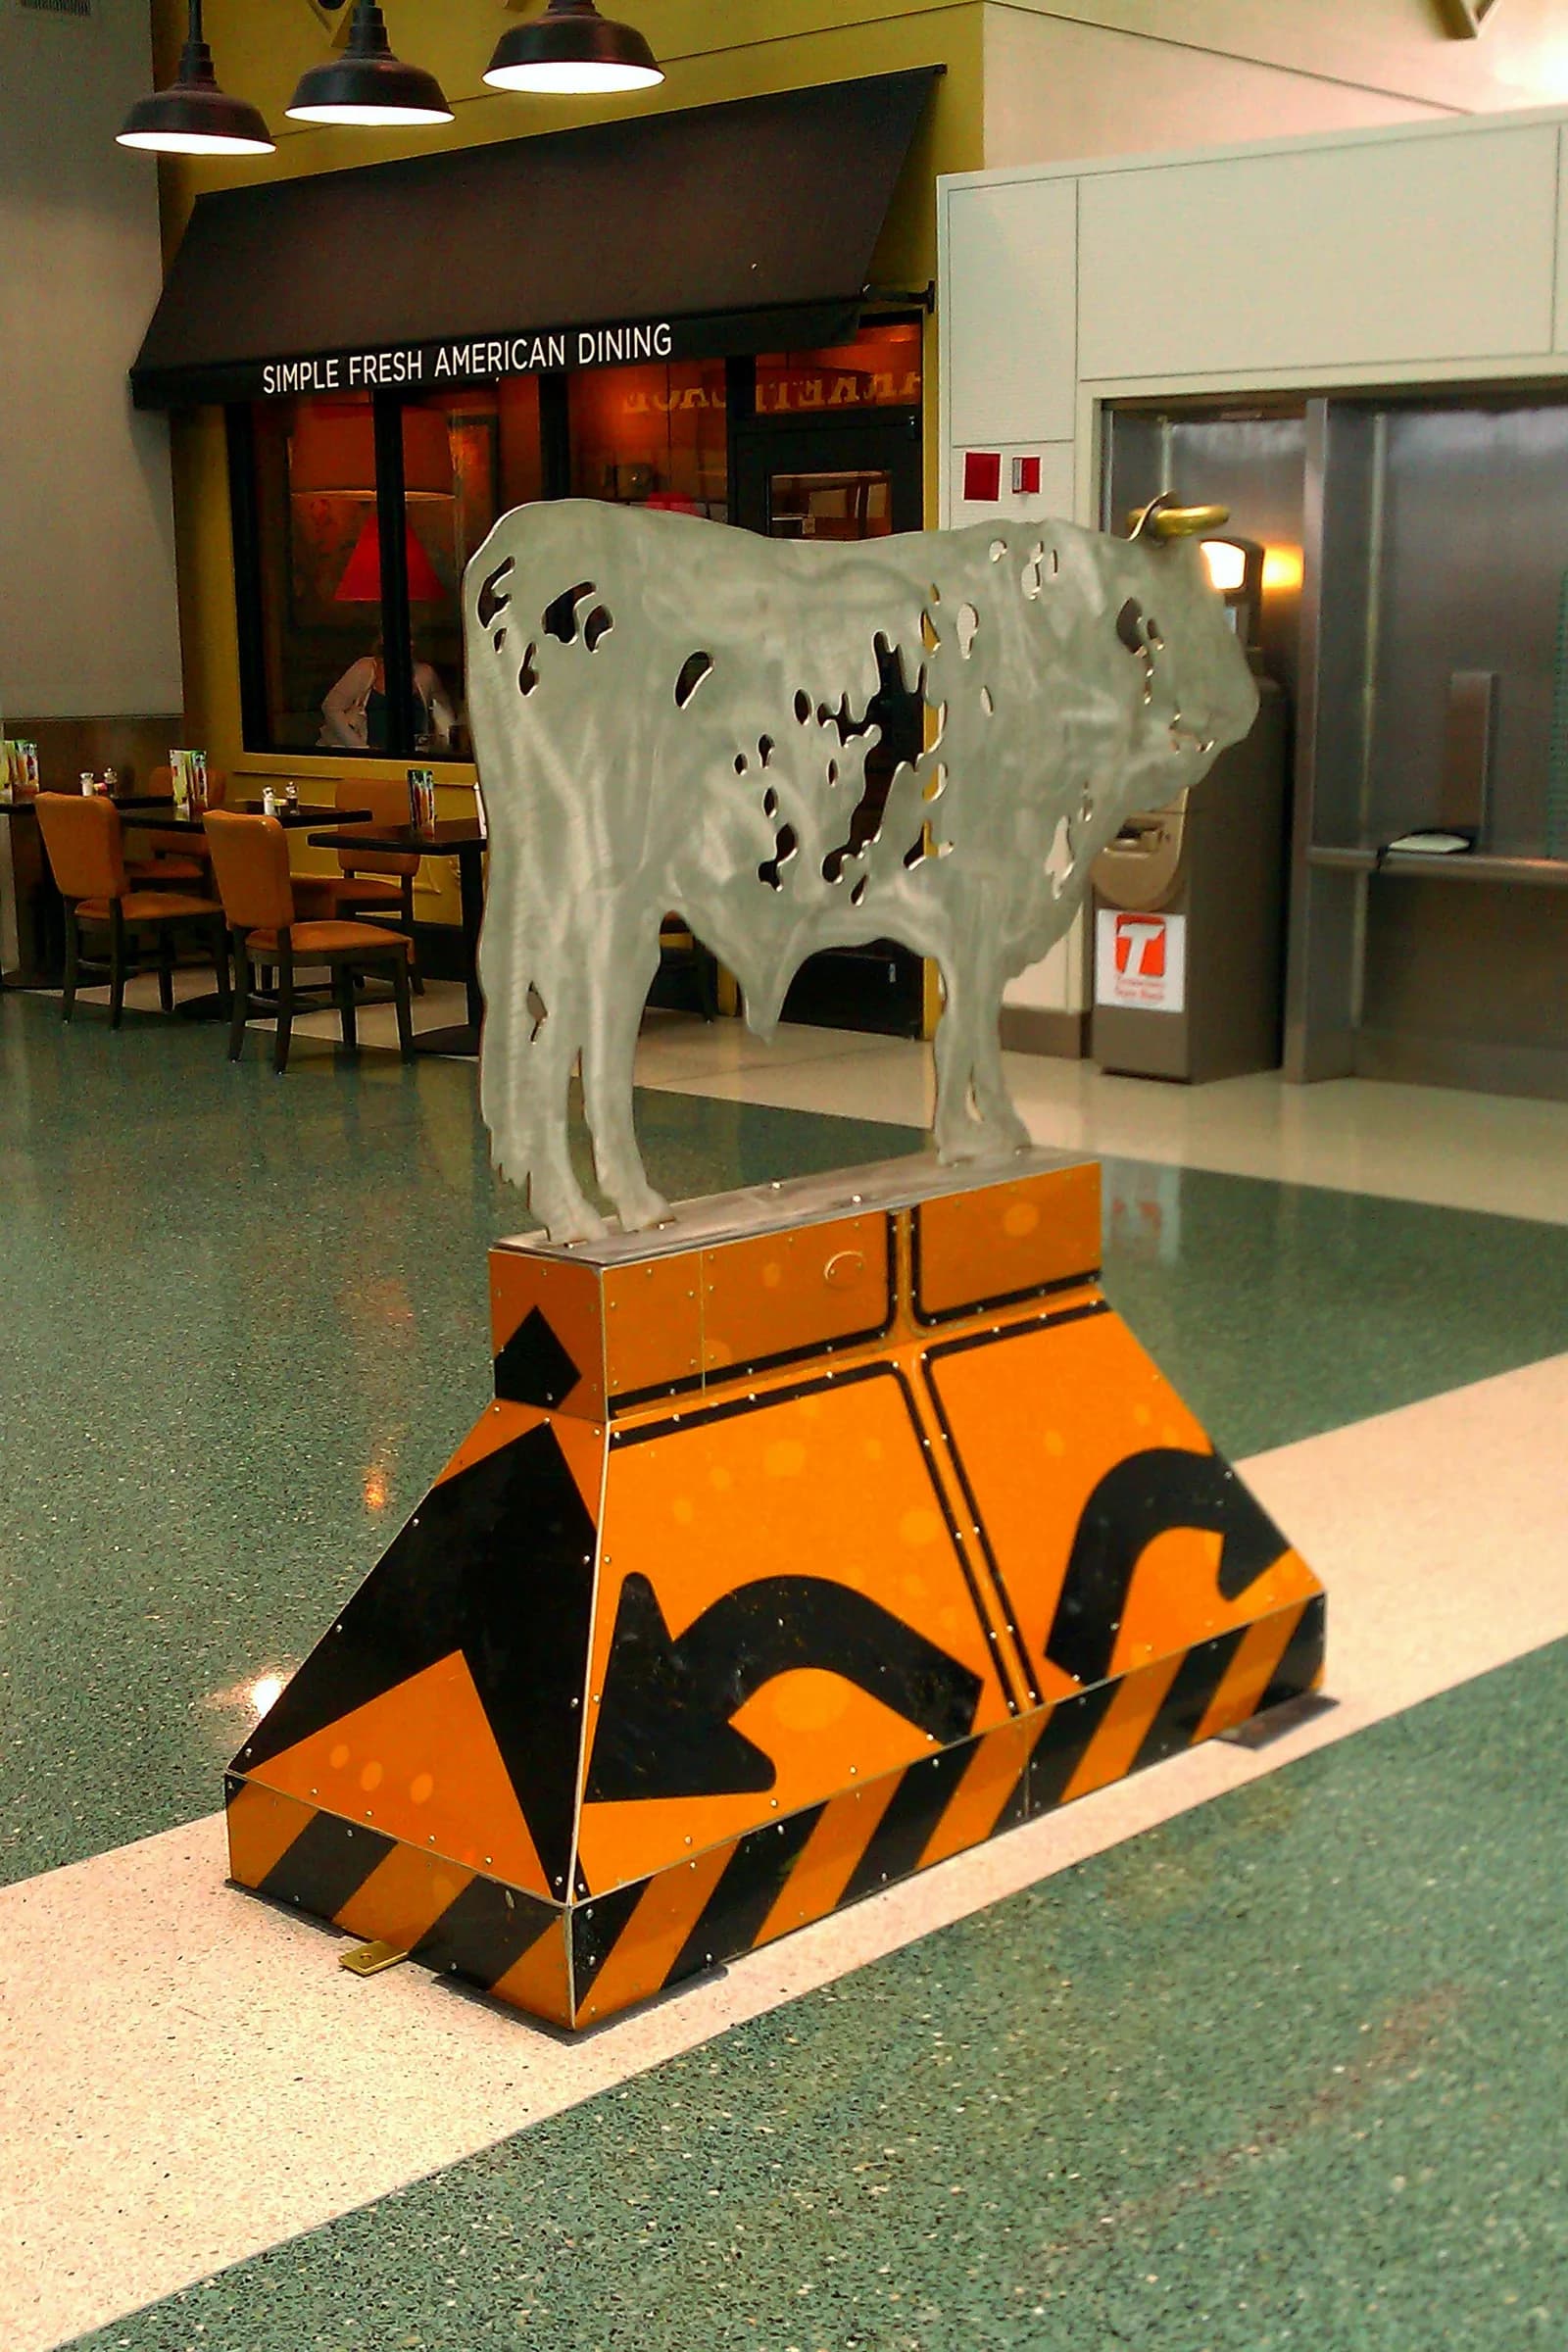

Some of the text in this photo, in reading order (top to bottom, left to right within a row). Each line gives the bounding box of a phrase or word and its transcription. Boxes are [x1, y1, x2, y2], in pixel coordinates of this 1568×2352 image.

[263, 322, 673, 394] SIMPLE FRESH AMERICAN DINING
[1117, 922, 1164, 977] T
